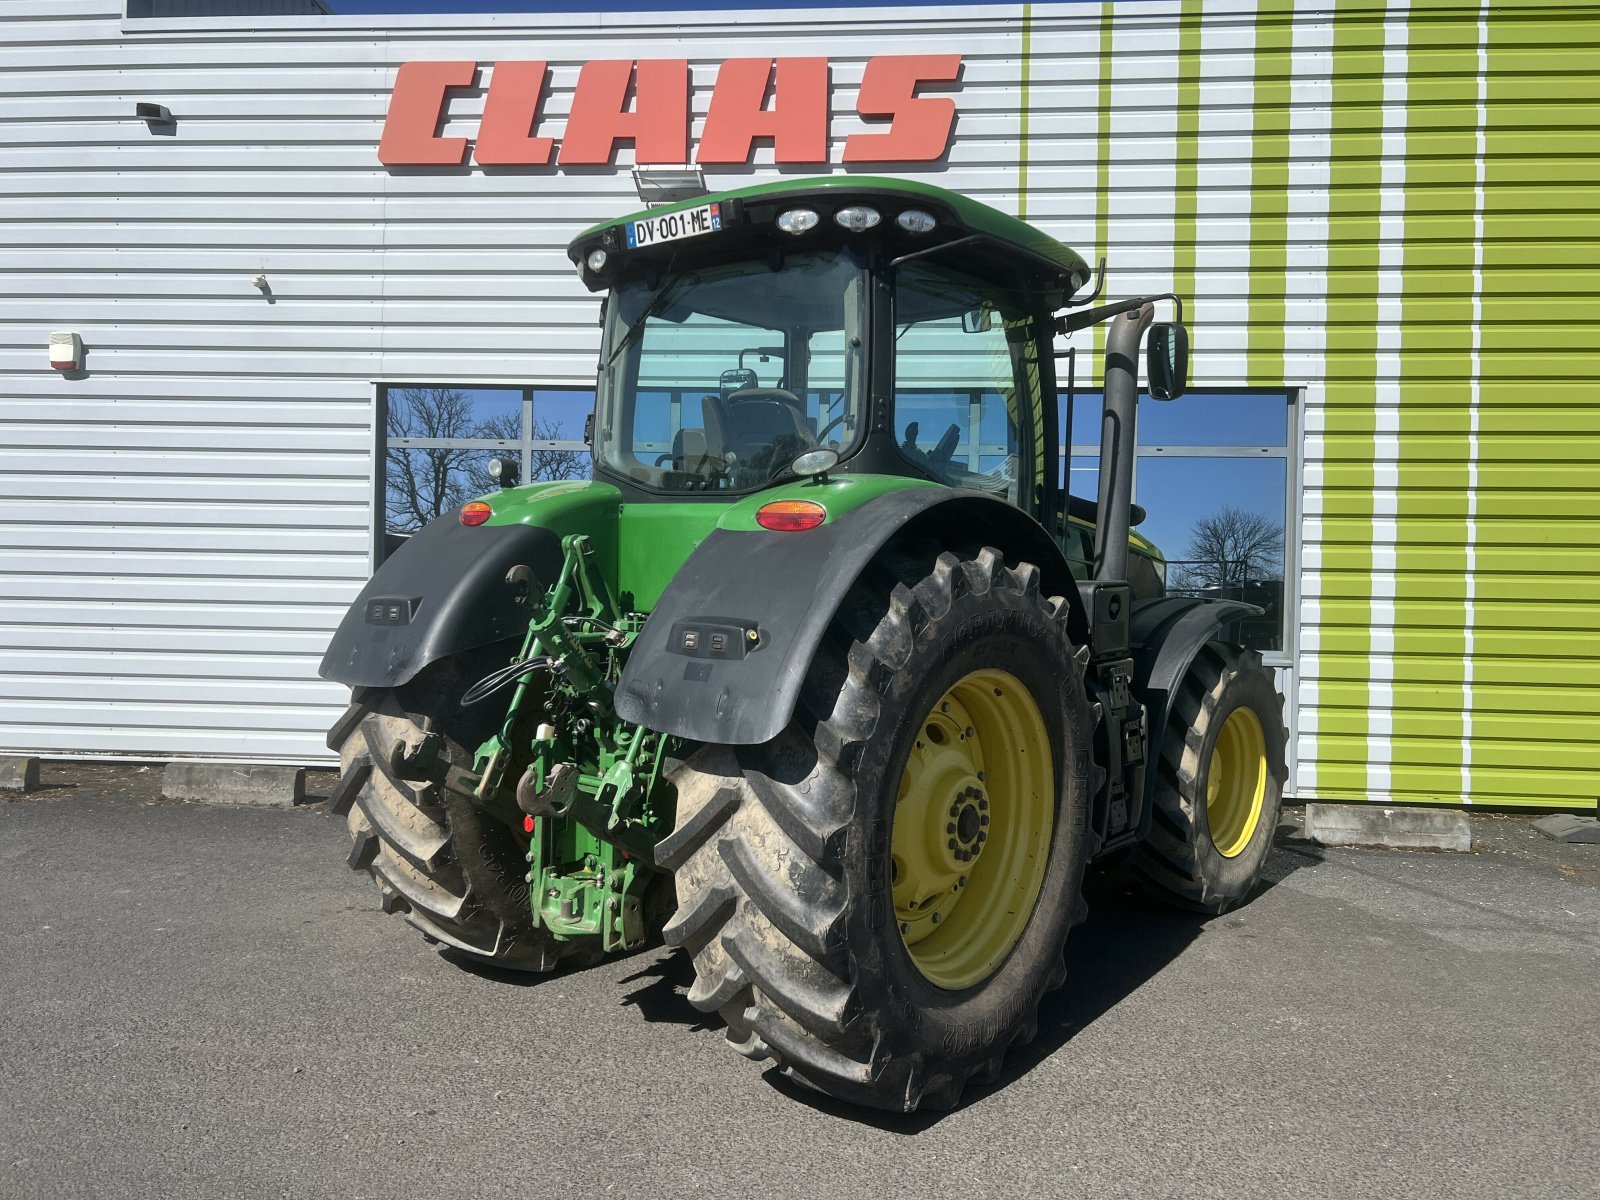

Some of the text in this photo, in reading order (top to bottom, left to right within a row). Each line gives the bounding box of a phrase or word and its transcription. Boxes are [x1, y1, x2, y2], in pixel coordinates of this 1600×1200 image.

[378, 54, 963, 165] CLAAS
[636, 208, 711, 244] DV-001-ME
[712, 217, 721, 229] 12
